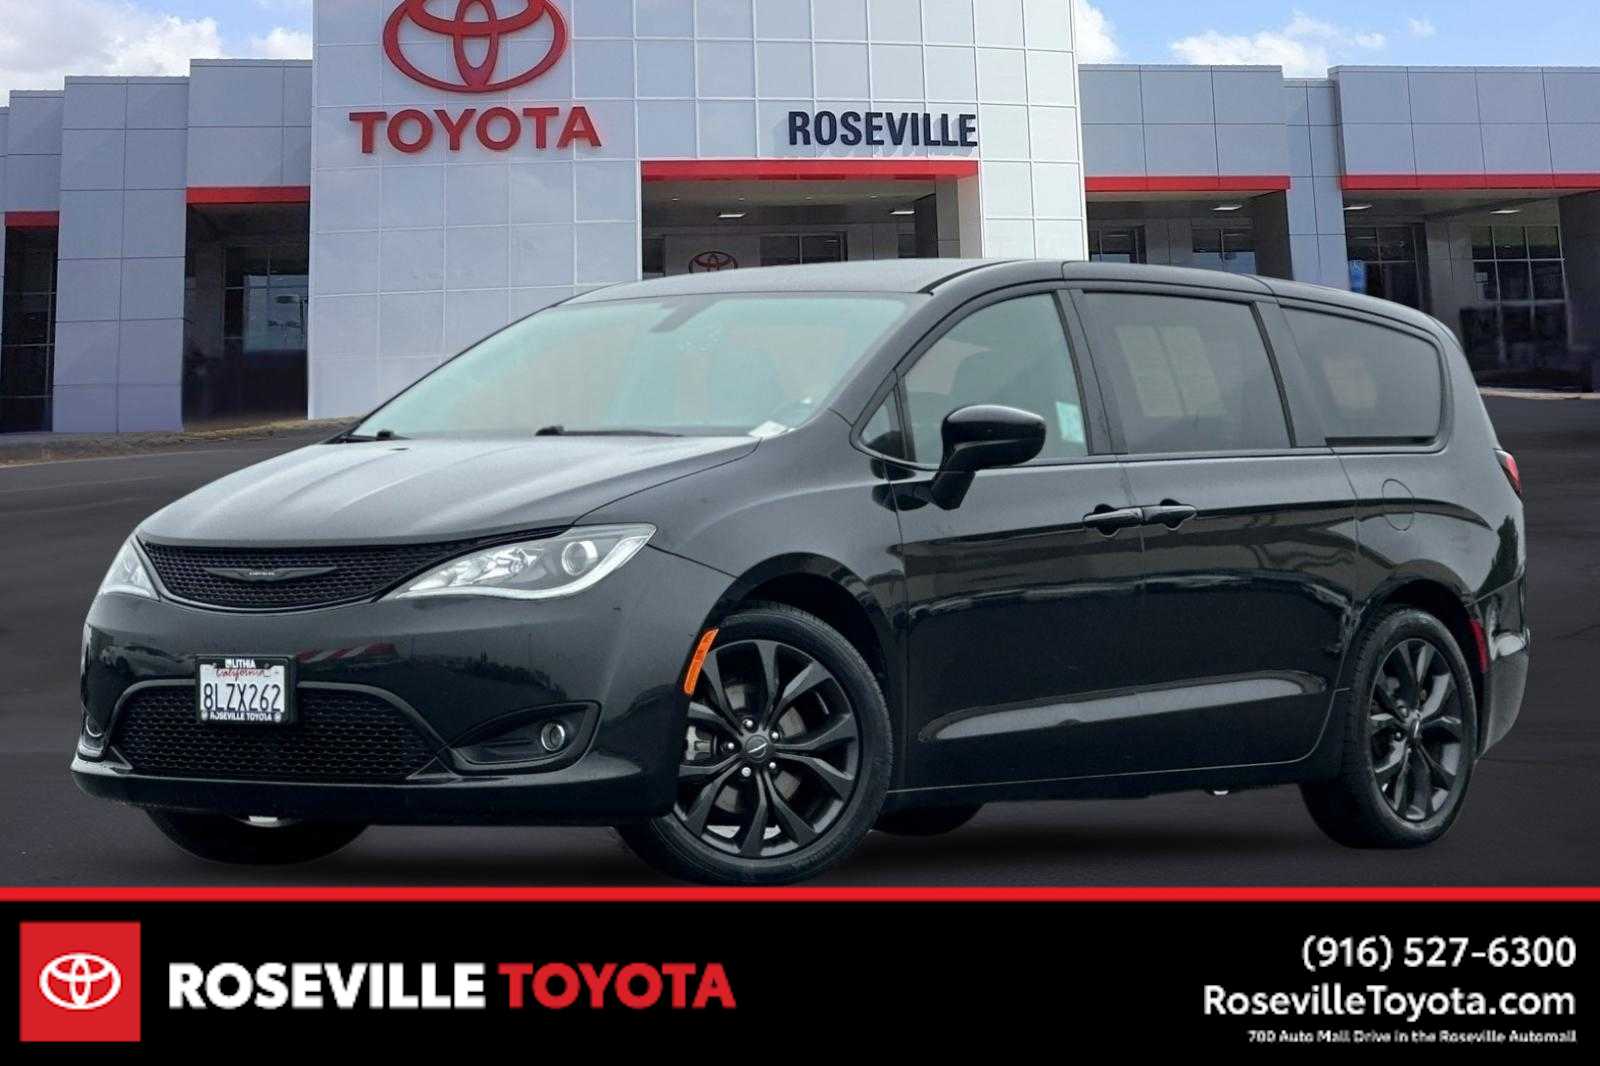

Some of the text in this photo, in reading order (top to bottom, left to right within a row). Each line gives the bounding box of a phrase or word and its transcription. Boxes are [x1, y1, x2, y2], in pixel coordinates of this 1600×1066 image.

[349, 106, 602, 154] TOYOTA
[788, 110, 979, 148] ROSEVILLE
[203, 682, 281, 712] 8LZX262
